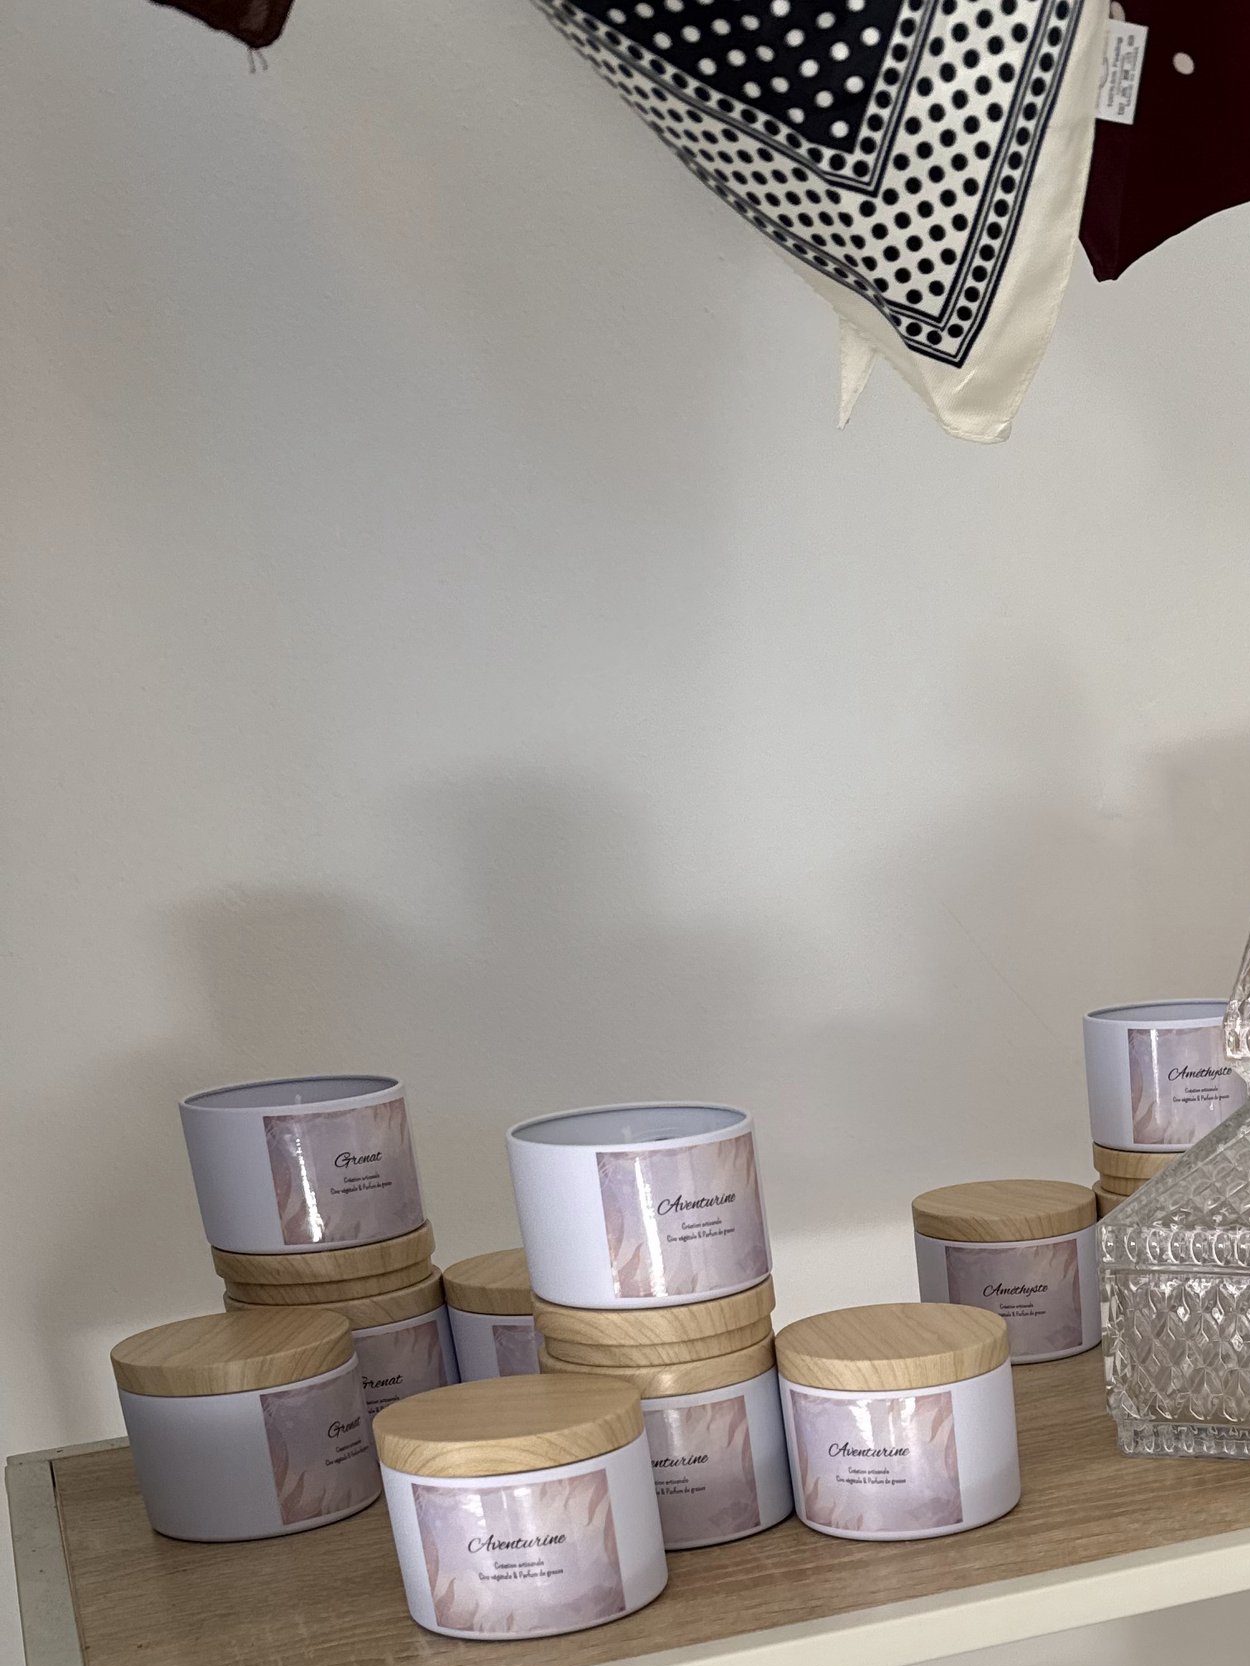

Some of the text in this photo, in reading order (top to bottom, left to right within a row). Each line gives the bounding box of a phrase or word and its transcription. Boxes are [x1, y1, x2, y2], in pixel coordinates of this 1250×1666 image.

[1168, 1065, 1232, 1081] Améthyste
[335, 1152, 382, 1168] Grenat
[657, 1193, 736, 1216] Aventurine
[983, 1283, 1048, 1297] Améthyste
[828, 1442, 910, 1457] Aventurine
[651, 1455, 709, 1467] enturine
[468, 1534, 566, 1554] Aventurine
